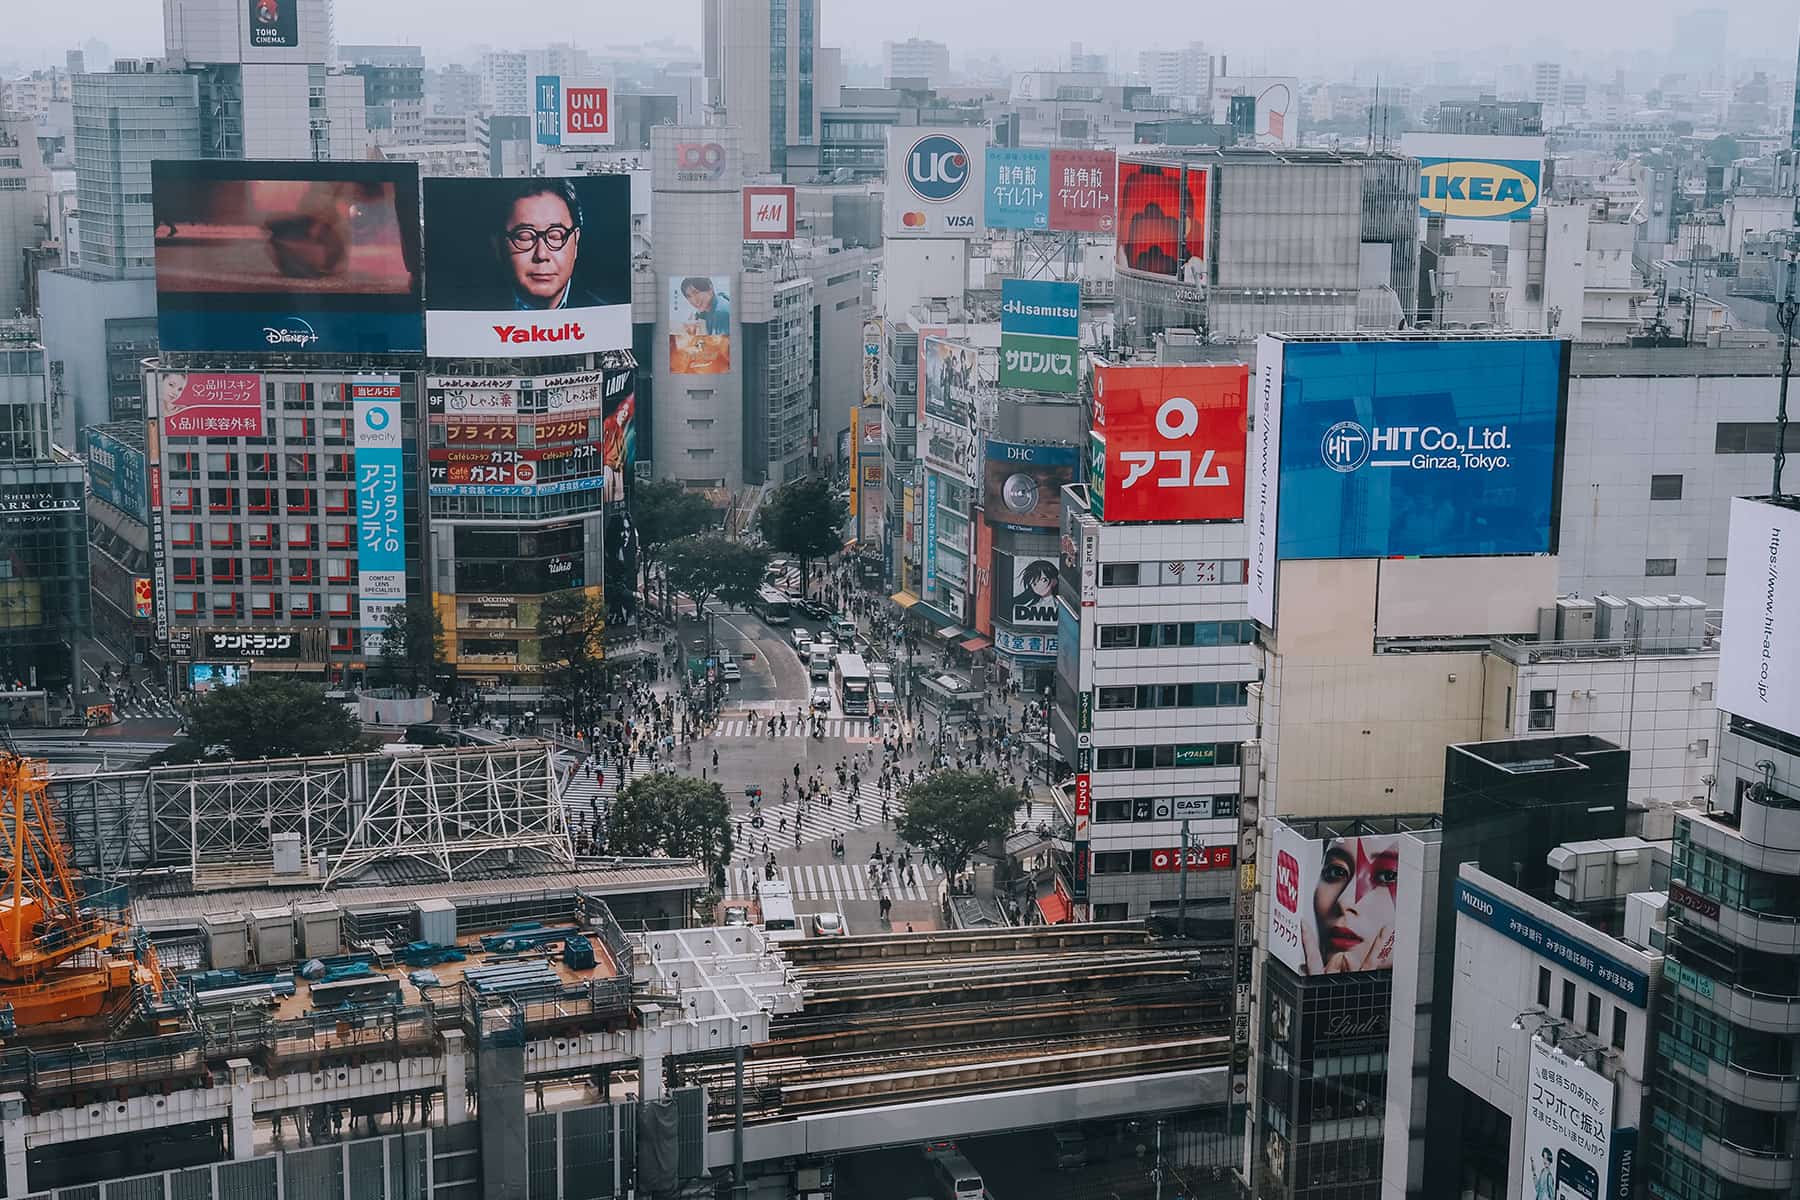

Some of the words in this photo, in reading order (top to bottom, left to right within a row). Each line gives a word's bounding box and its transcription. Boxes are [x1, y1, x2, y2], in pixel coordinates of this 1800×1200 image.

[255, 28, 278, 36] TOHO
[541, 84, 555, 110] THE
[571, 94, 601, 110] UNI
[571, 112, 604, 131] QLO
[999, 164, 1038, 186] 龍角散
[1063, 167, 1104, 188] 龍角散
[1420, 175, 1527, 203] IKEA
[945, 216, 975, 227] VISA
[492, 323, 586, 344] Yakult
[1005, 350, 1073, 376] サロンパス
[205, 379, 256, 391] 品川スキン
[357, 386, 396, 397] 当ビル5F
[205, 391, 251, 402] クリニック
[429, 396, 444, 406] 9F
[178, 417, 257, 431] 品川美容外科
[359, 431, 397, 443] eyecity
[1371, 427, 1419, 451] HIT
[1007, 447, 1034, 460] DHC
[1411, 455, 1461, 471] Ginza,
[1461, 453, 1510, 472] Tokyo.
[430, 467, 447, 478] 7F
[470, 466, 511, 481] ガスト
[1119, 450, 1230, 489] アコム
[1257, 365, 1273, 595] https://www.hit-ad.co.jp/
[360, 464, 382, 553] アイシティ
[383, 464, 399, 553] コンタクトの
[1757, 527, 1782, 703] https://www.hit-ad.co.jp/
[213, 634, 292, 649] サンドラッグ
[1176, 801, 1208, 809] EAST
[1215, 852, 1228, 863] 3F
[1462, 889, 1493, 916] MIZUHO
[1509, 919, 1543, 945] みずほ銀行
[1546, 938, 1594, 973] みずほ信託銀行
[1598, 966, 1635, 993] みずほ証券
[1532, 1082, 1606, 1143] スマホで振込
[1619, 1150, 1633, 1198] MIZUHO
